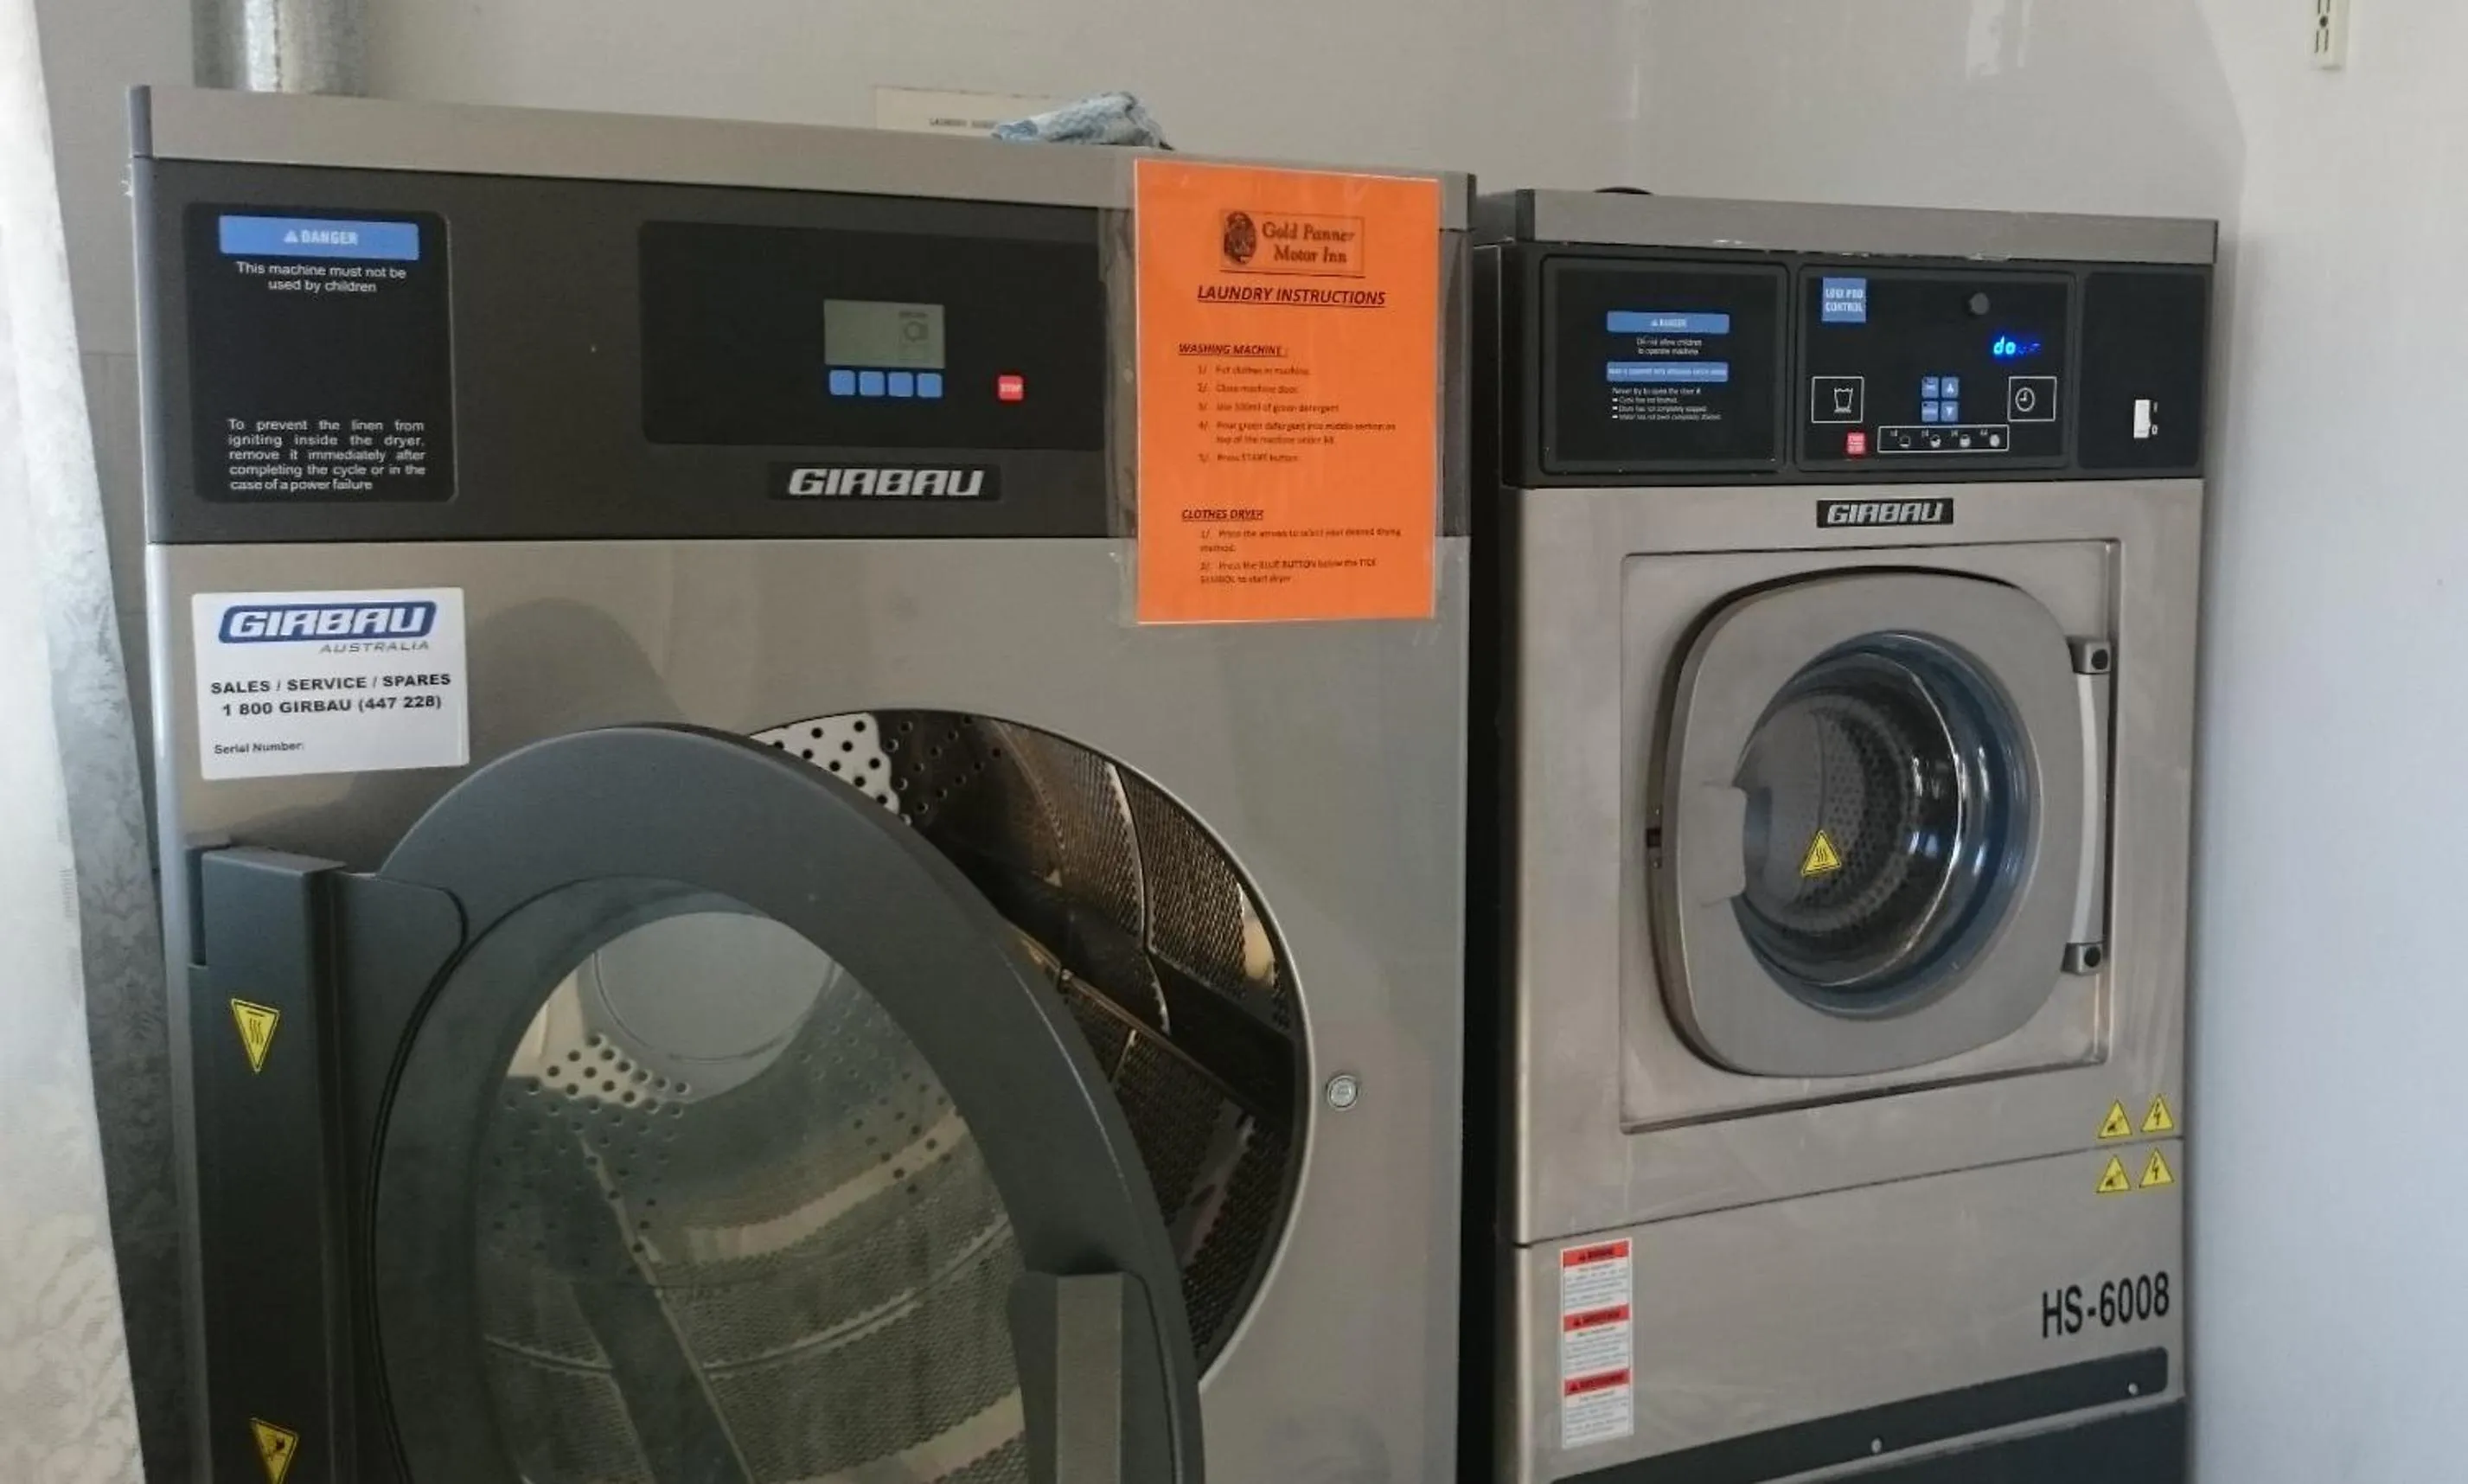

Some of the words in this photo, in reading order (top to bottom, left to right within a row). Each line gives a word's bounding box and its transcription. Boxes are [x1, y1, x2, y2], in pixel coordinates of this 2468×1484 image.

[302, 231, 359, 246] DANGER
[1262, 221, 1298, 239] Gold
[1303, 224, 1355, 242] Panner
[1274, 244, 1319, 263] Motor
[1323, 246, 1347, 263] Inn
[235, 261, 265, 275] This
[269, 263, 326, 277] machine
[329, 266, 362, 278] must
[366, 267, 386, 278] not
[389, 267, 406, 279] be
[268, 279, 301, 291] used
[304, 280, 321, 294] by
[324, 280, 377, 292] children
[1197, 285, 1272, 301] LAUNDRY
[1276, 288, 1386, 305] INSTRUCTIONS
[1826, 302, 1863, 312] CONTROL
[1179, 343, 1231, 355] WASHING
[1233, 345, 1282, 356] MACHINE
[227, 419, 245, 431] To
[256, 419, 308, 433] prevent
[318, 419, 341, 431] the
[351, 419, 383, 431] linen
[393, 419, 425, 432] from
[228, 434, 283, 448] igniting
[294, 434, 338, 445] inside
[349, 435, 373, 446] the
[229, 450, 280, 460] remove
[289, 449, 298, 460] it
[308, 449, 387, 464] immediately
[396, 450, 426, 461] after
[229, 464, 303, 477] completing
[307, 464, 328, 475] the
[333, 464, 367, 477] cycle
[370, 466, 384, 476] or
[389, 464, 401, 475] in
[405, 464, 425, 475] the
[230, 481, 263, 490] case
[264, 478, 278, 490] of
[279, 481, 288, 490] a
[291, 481, 330, 493] power
[332, 478, 373, 490] failure
[787, 467, 985, 497] GIRBAU
[1182, 509, 1228, 520] CLOTHES
[1230, 509, 1264, 520] DRYER
[1827, 502, 1944, 525] GIRBAU
[229, 605, 426, 637] GIRBAU
[319, 641, 429, 655] AUSTRALIA
[210, 681, 271, 695] SALES
[287, 676, 368, 692] SERVICE
[382, 674, 451, 688] SPARES
[223, 704, 232, 717] 1
[239, 701, 272, 716] 800
[279, 699, 351, 713] GIRBAU
[358, 696, 396, 713] (447
[403, 695, 442, 711] 228)
[214, 743, 250, 755] Serial
[253, 741, 304, 754] Number:
[2042, 1270, 2171, 1339] HS-6008
